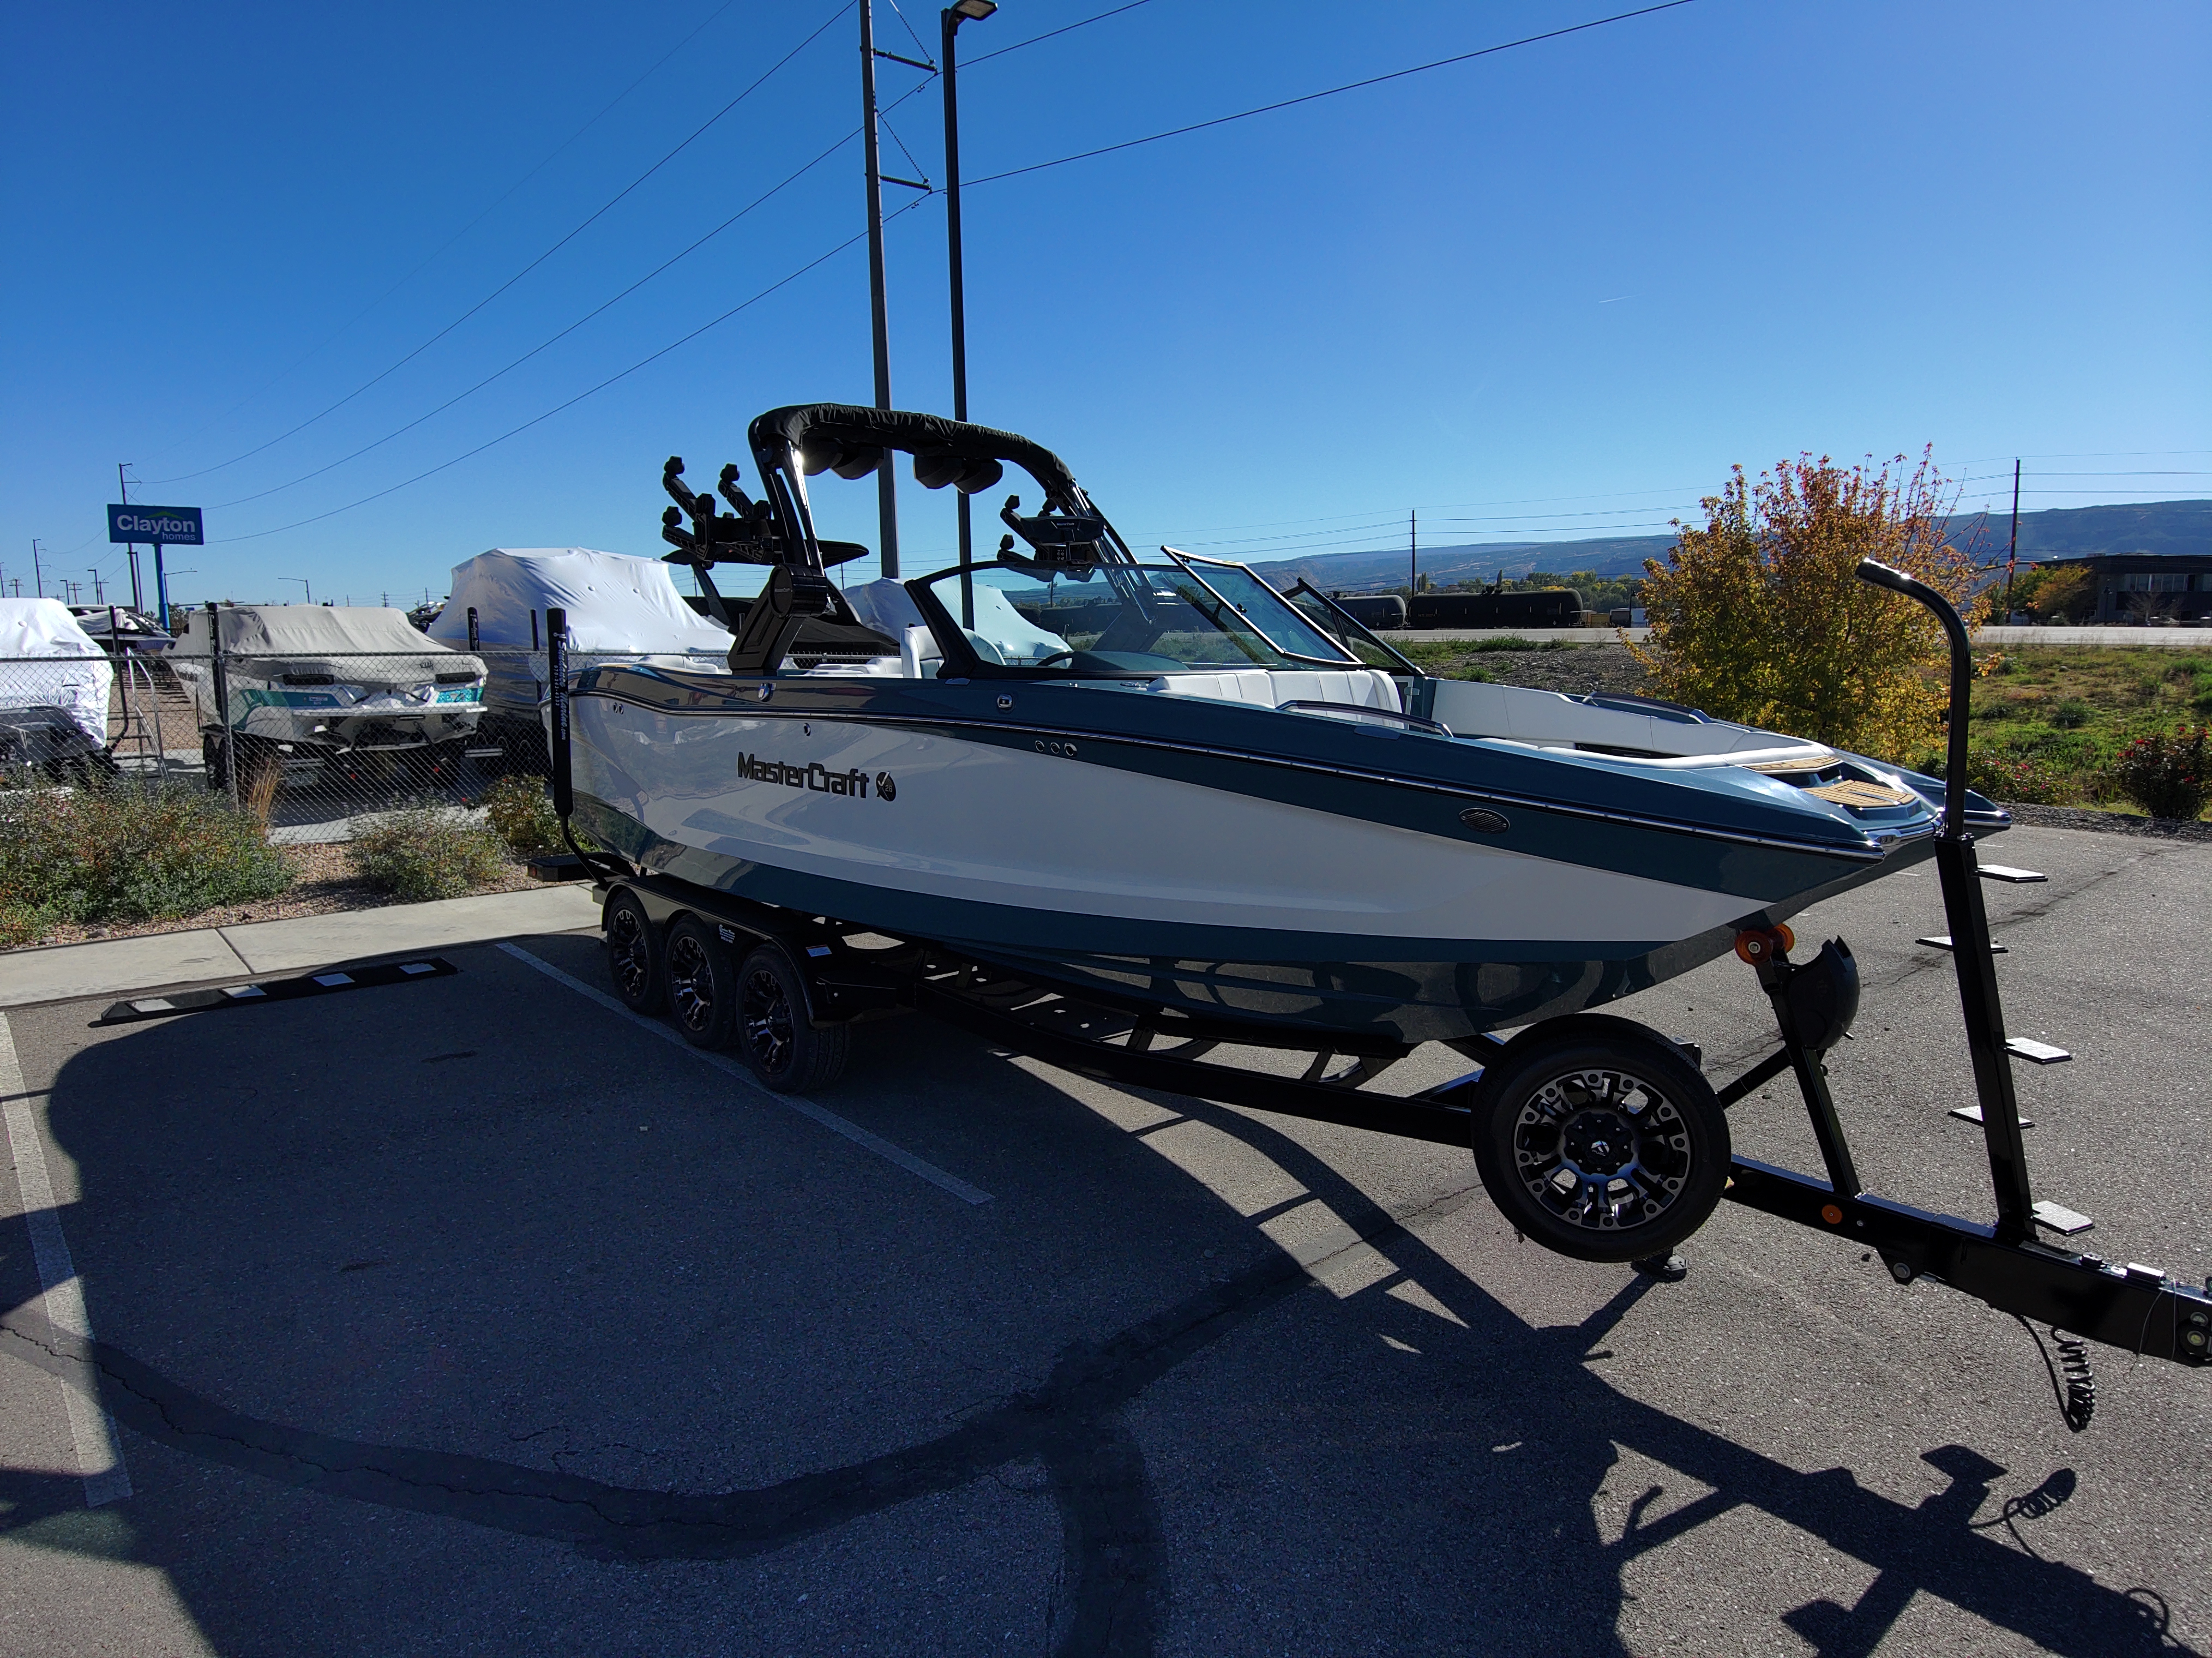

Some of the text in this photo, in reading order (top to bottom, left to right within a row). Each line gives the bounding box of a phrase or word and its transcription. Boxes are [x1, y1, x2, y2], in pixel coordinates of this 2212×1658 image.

[117, 514, 195, 534] Clayton
[162, 532, 196, 540] homes
[557, 640, 569, 740] Sundance Marine.com
[737, 752, 870, 798] MasterCraft
